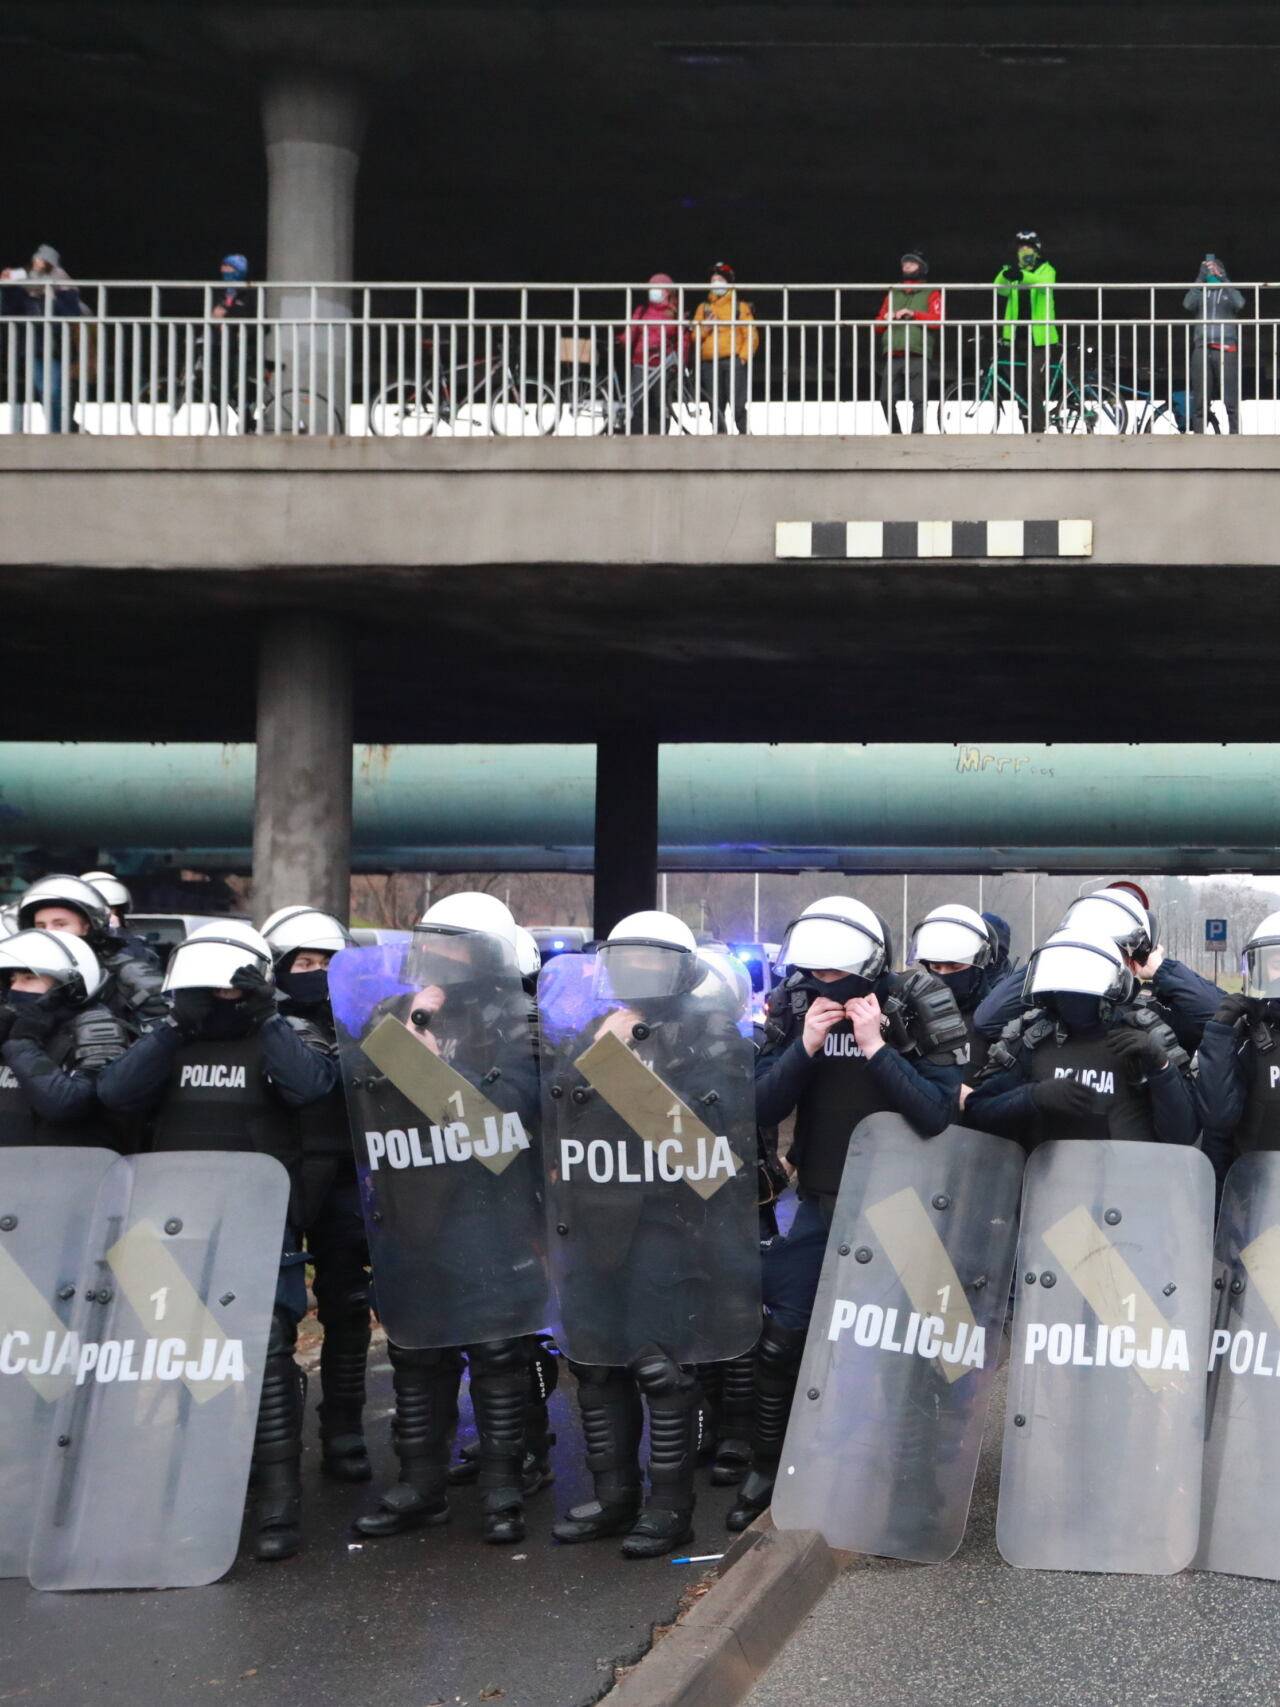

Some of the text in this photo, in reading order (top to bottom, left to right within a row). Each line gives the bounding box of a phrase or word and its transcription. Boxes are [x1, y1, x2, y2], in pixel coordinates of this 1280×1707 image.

[1210, 921, 1223, 938] P
[181, 1065, 246, 1088] POLICJA
[447, 1091, 465, 1117] 1
[666, 1105, 683, 1134] 1
[365, 1112, 530, 1171] POLICJA
[560, 1136, 736, 1183] POLICJA
[150, 1286, 168, 1321] 1
[937, 1285, 951, 1314] 1
[1121, 1293, 1136, 1322] 1
[828, 1299, 986, 1369] POLICJA
[1024, 1323, 1190, 1372] POLICJA
[75, 1338, 245, 1386] POLICJA
